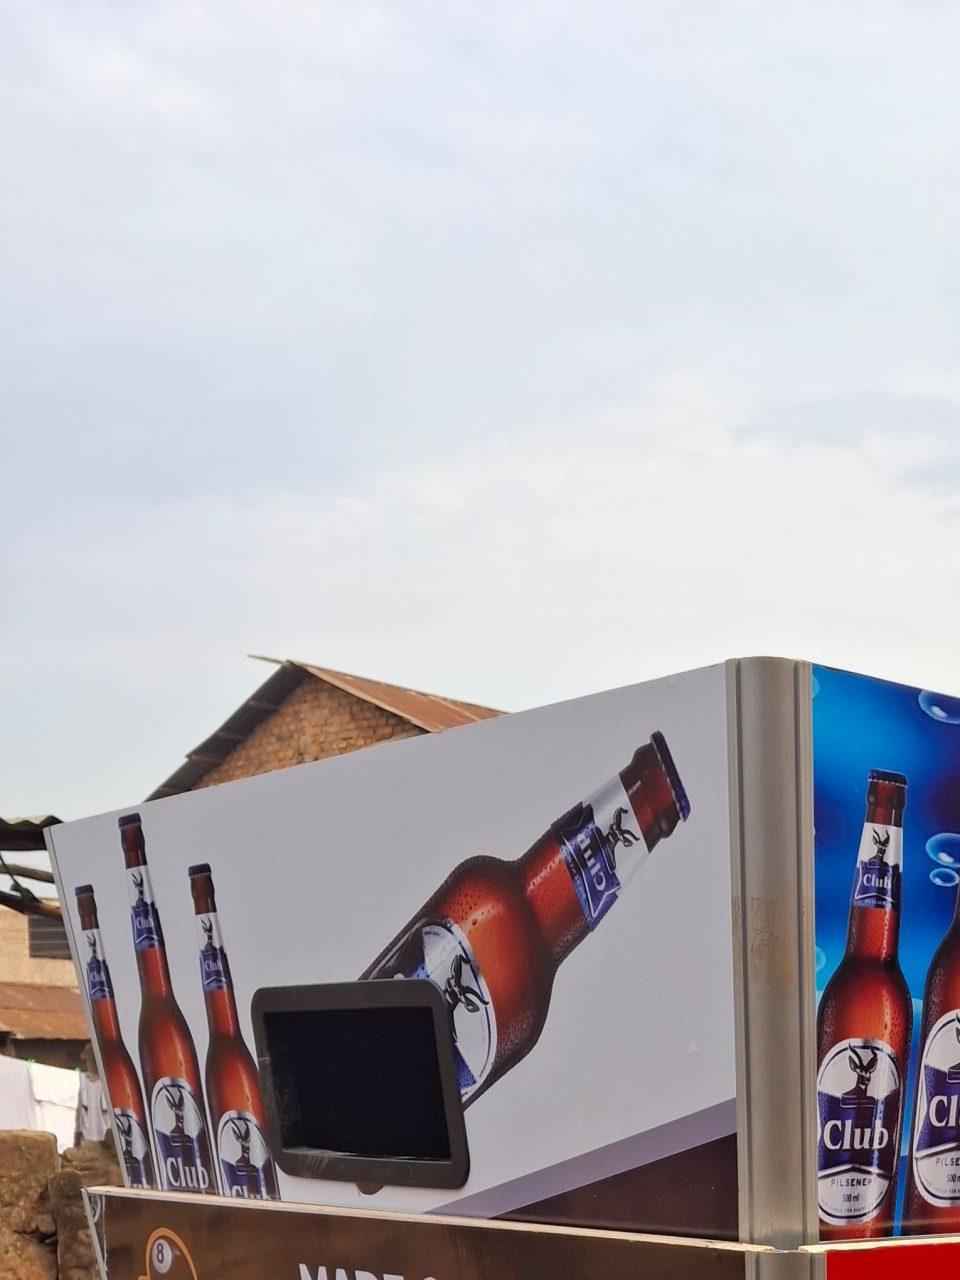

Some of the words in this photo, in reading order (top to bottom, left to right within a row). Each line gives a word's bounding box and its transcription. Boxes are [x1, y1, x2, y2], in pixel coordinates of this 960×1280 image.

[863, 873, 891, 888] Club
[823, 1119, 889, 1150] Club
[166, 1157, 210, 1189] Club
[157, 1242, 166, 1264] 8
